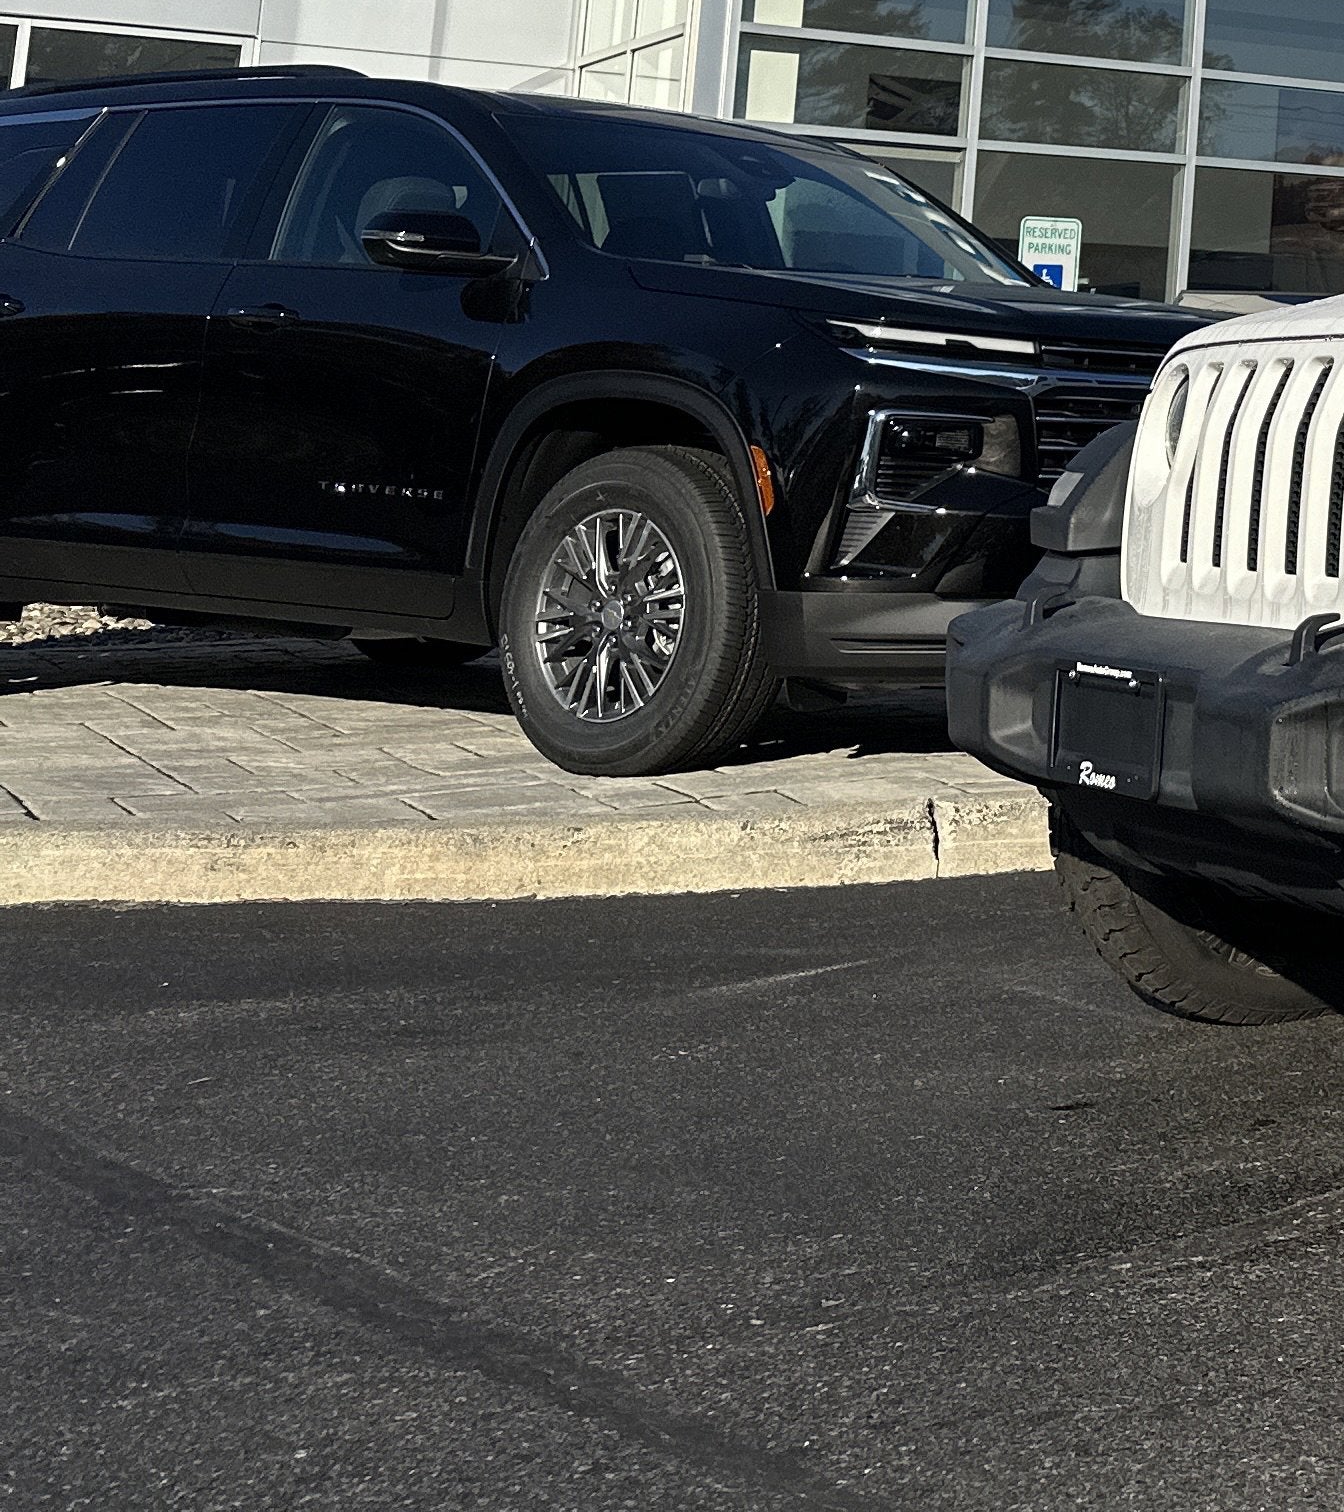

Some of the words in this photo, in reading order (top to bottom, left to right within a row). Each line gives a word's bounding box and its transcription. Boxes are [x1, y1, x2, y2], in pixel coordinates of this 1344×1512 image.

[1025, 226, 1076, 239] RESERVED
[1027, 242, 1072, 255] PARKING
[1078, 760, 1116, 790] Romeo
